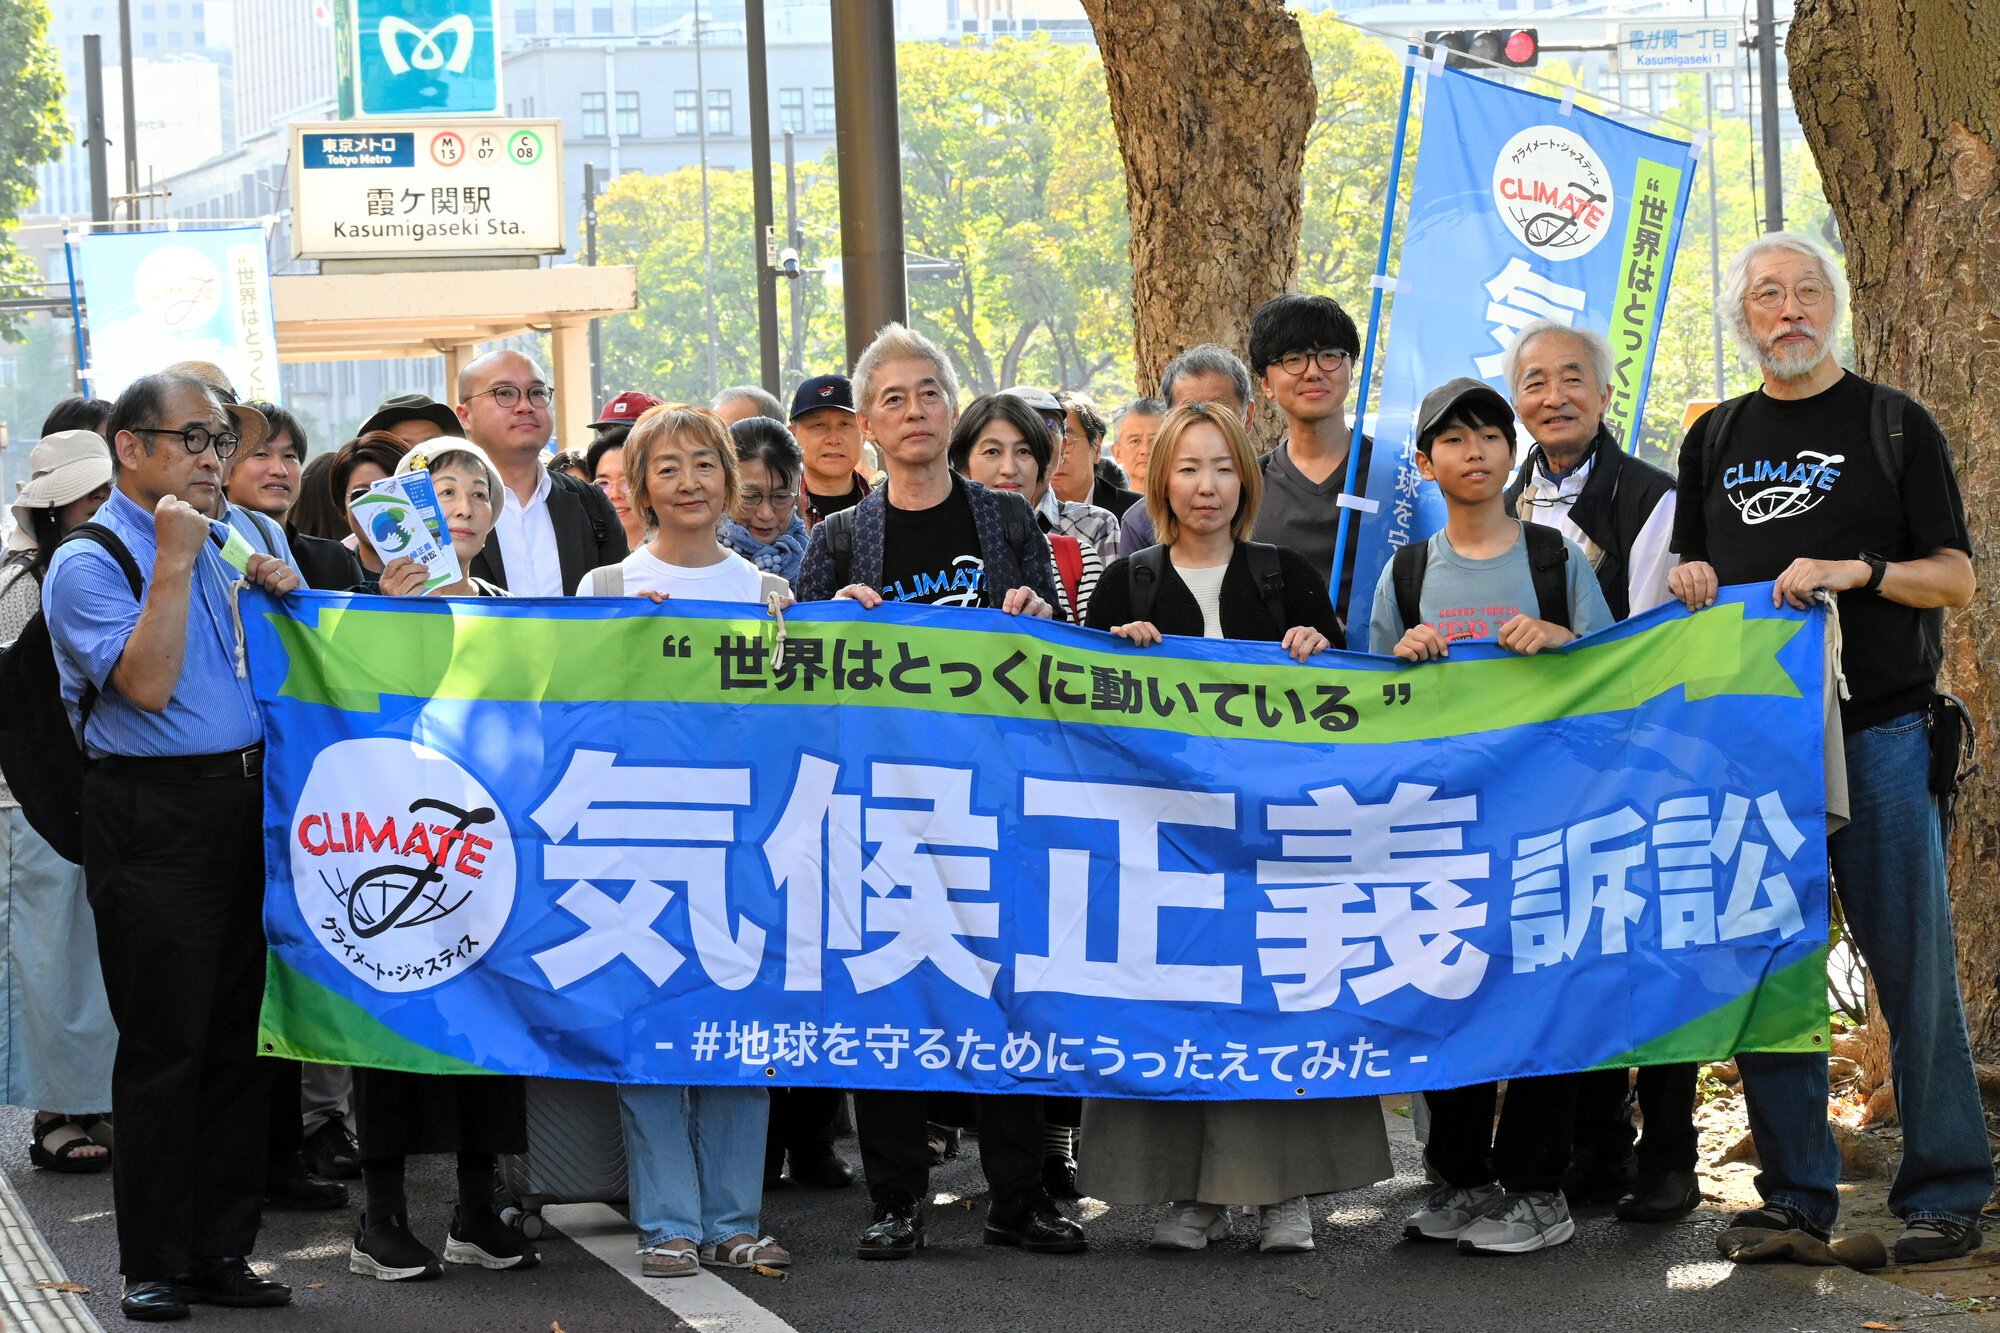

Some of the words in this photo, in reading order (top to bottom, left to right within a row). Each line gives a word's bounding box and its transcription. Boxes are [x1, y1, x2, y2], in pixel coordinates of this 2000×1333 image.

[1629, 28, 1728, 50] 霞が関一丁目
[1637, 54, 1712, 68] Kasumigaseki
[1716, 53, 1721, 63] 1
[321, 138, 396, 153] 東京メトロ
[441, 138, 453, 147] M
[481, 137, 491, 146] H
[521, 137, 529, 146] C
[327, 155, 358, 166] Tokyo
[360, 154, 392, 164] Metro
[440, 149, 456, 159] 15
[478, 148, 494, 159] 07
[517, 148, 533, 158] 08
[1500, 177, 1605, 230] CLIMATE
[334, 219, 479, 241] Kasumigaseki
[487, 218, 526, 235] Sta.
[1722, 459, 1841, 491] CLIMATE
[298, 811, 493, 879] CLIMATE
[321, 917, 479, 982] クライメート・ジャスティス
